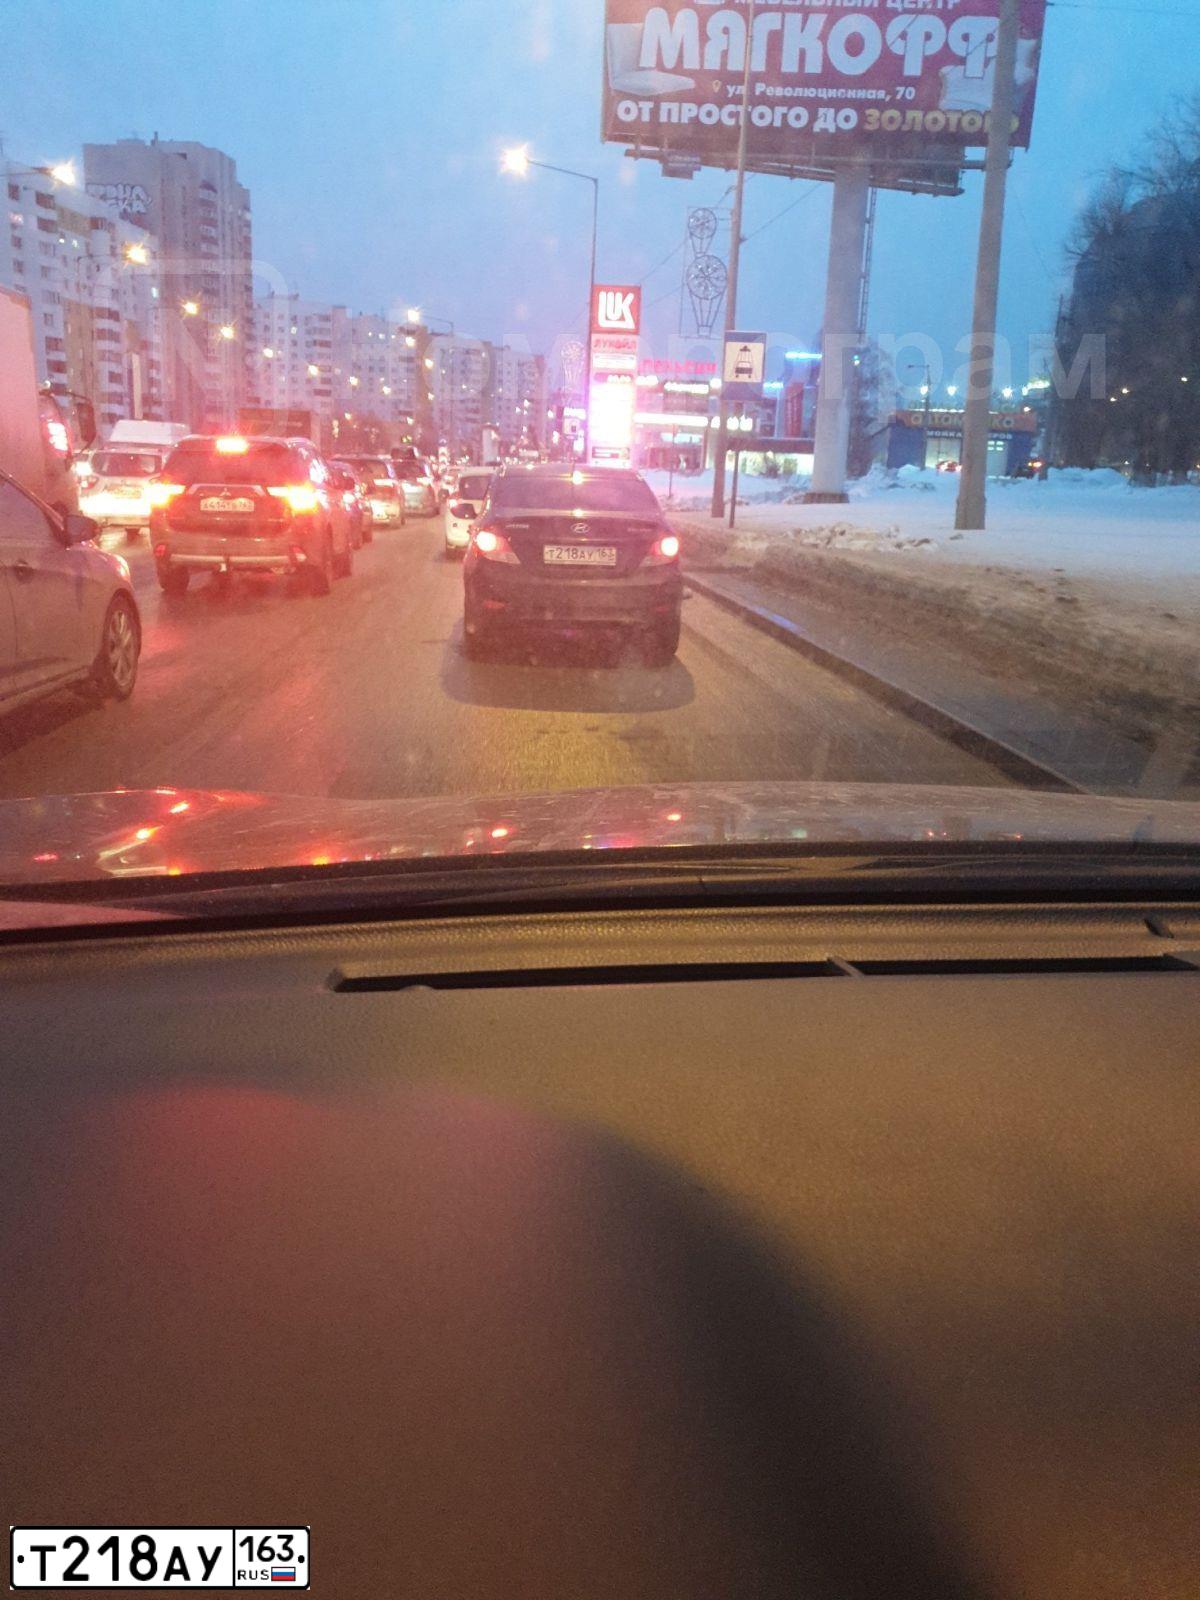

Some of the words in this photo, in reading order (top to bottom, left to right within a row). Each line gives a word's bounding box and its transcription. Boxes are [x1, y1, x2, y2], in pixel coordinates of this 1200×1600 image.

[639, 7, 999, 79] МЯГКОФФ
[755, 82, 891, 101] Революционная,
[895, 87, 916, 100] 70
[617, 100, 654, 122] ОТ
[659, 102, 809, 130] ПРОСТОГО
[813, 107, 858, 133] ДО
